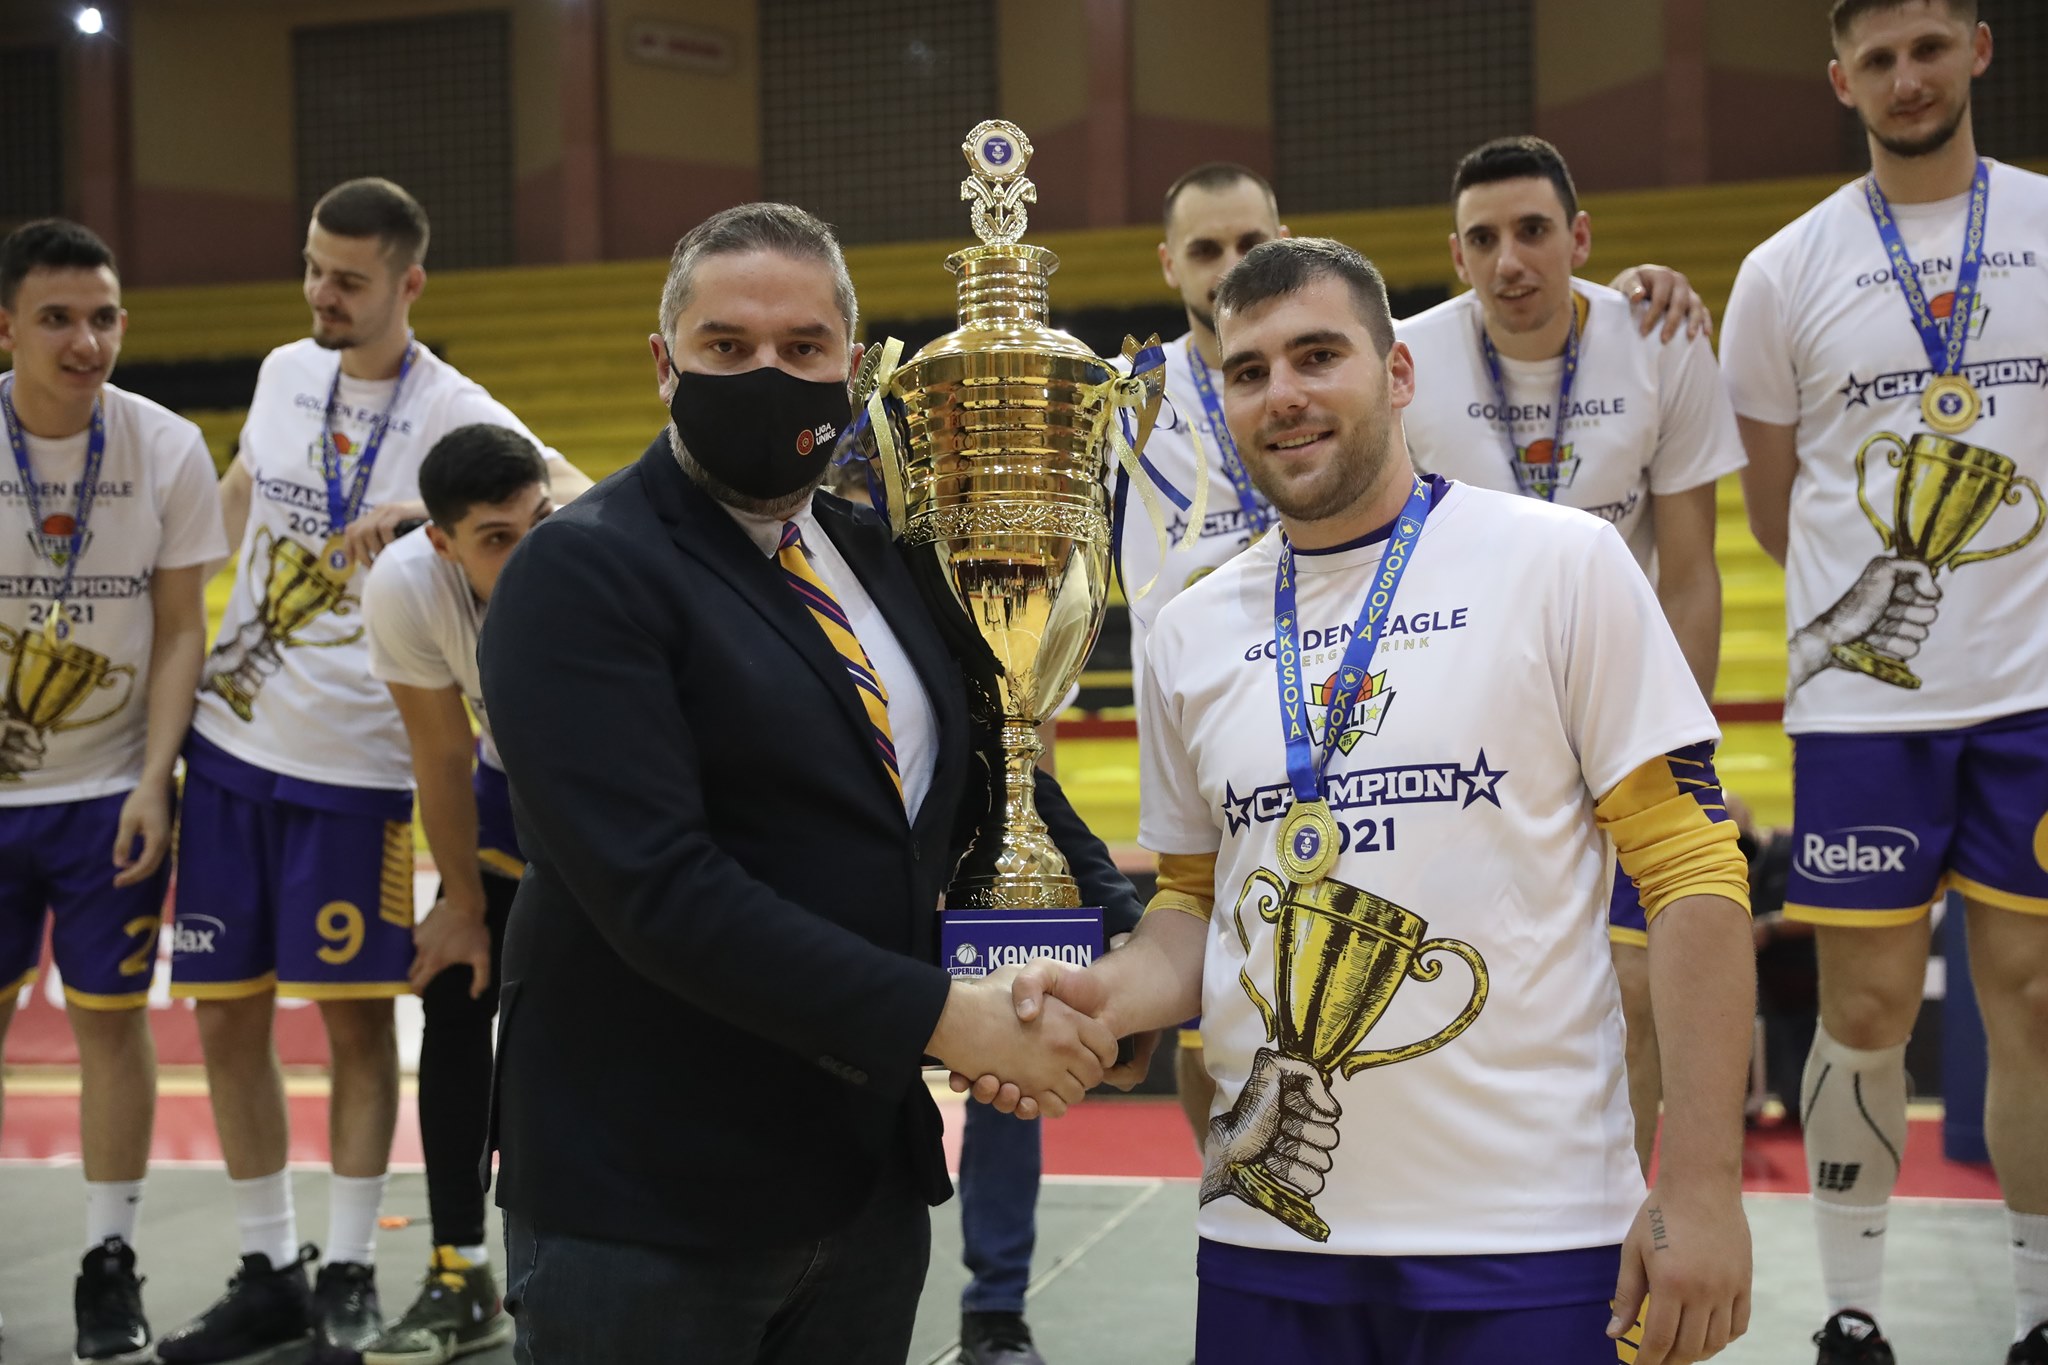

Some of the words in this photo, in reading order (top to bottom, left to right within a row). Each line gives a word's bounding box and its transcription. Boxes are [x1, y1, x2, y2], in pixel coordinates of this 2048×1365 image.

[1964, 192, 1986, 264] KOSOVA
[1978, 251, 2037, 268] AGLE
[1893, 257, 1933, 329] KOSOVA
[1875, 361, 2040, 398] CHAPION
[294, 393, 352, 418] GOLEN
[814, 422, 832, 437] LIGA
[815, 428, 837, 445] UNIKE
[0, 481, 66, 496] OLEN
[74, 481, 134, 497] EGLE
[289, 512, 330, 538] 202
[1279, 548, 1290, 592] OVA
[1358, 538, 1410, 642] KOSOVA
[29, 603, 94, 622] 221
[1244, 620, 1358, 662] GODEN
[1380, 636, 1430, 653] RINK
[1279, 633, 1303, 740] KOSOVA
[1255, 767, 1458, 821] CHMPION
[1803, 833, 1906, 874] Relax
[174, 920, 216, 953] lax
[315, 900, 365, 964] 9
[949, 967, 984, 976] SUPERLIGA
